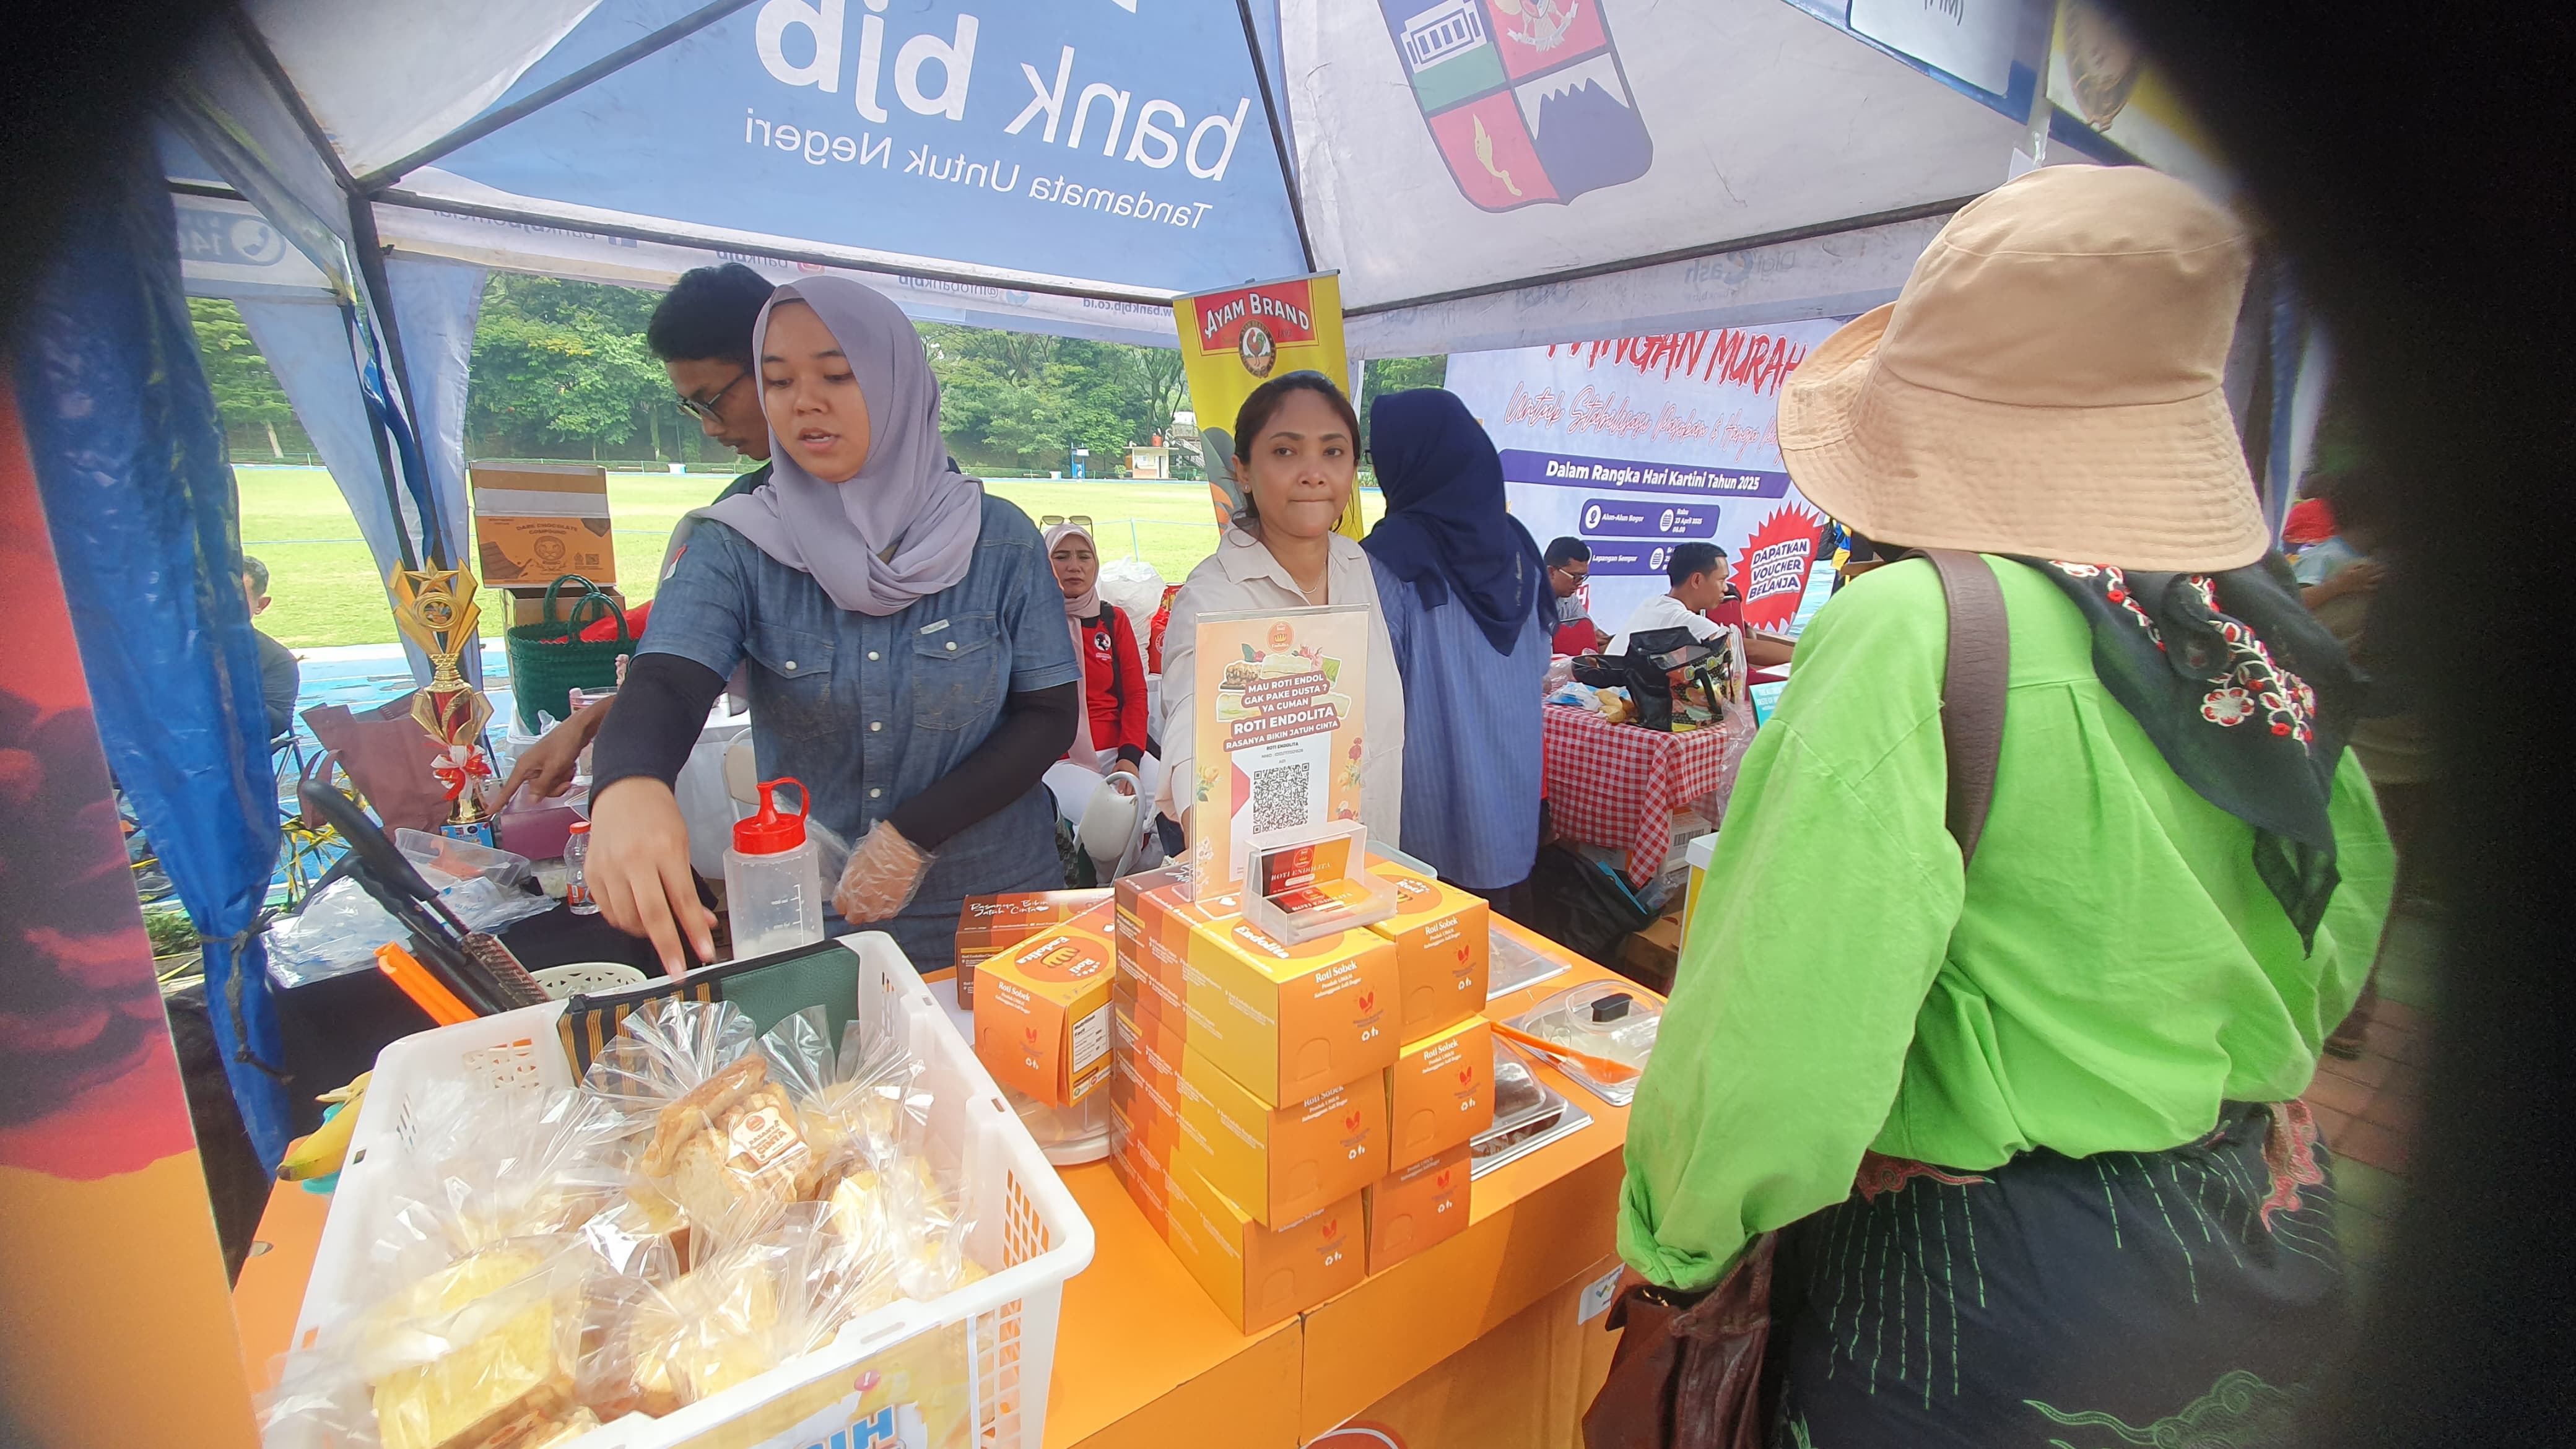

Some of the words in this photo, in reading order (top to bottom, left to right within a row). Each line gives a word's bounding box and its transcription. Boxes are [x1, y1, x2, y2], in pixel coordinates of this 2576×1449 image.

[1204, 298, 1245, 339] AYAM
[1248, 292, 1310, 330] BRAND
[1703, 329, 1808, 398] MURAH
[1503, 381, 1565, 428] Untuk
[1546, 460, 1589, 481] Dalam
[1591, 464, 1640, 485] Rangka
[1643, 468, 1668, 485] Hari
[1670, 471, 1706, 488] Kartini
[1707, 473, 1737, 490] Tahun
[1737, 476, 1760, 490] 2025
[536, 523, 578, 532] CHOCOLATE
[1601, 513, 1628, 521] Alun-Alun
[1629, 515, 1644, 523] Bogor
[1592, 554, 1618, 563] Lapangan
[1618, 555, 1638, 564] Sempur
[1752, 540, 1808, 565] DAPATKAN
[1753, 559, 1802, 581] VOUCHER
[1749, 577, 1799, 599] BELANJA
[1248, 683, 1269, 693] MAU
[1271, 679, 1292, 689] ROTI
[1294, 674, 1324, 685] ENDOL
[1244, 694, 1264, 705] GAK
[1266, 690, 1290, 702] PAKE
[1292, 685, 1320, 697] DUSTA
[1262, 705, 1274, 713] YA
[1276, 698, 1308, 710] CUMAN
[1234, 718, 1266, 735] ROTI
[1269, 706, 1334, 728] ENDOLITA
[1226, 736, 1264, 749] RASANYA
[1266, 730, 1288, 741] BIKIN
[1289, 725, 1314, 736] JATUH
[1316, 720, 1338, 730] CINTA
[1271, 871, 1290, 881] ROTI
[1292, 862, 1331, 876] ENDOLITA
[1396, 880, 1425, 894] Roti
[970, 902, 1014, 911] Rasanya
[974, 908, 1004, 917] Jatuh
[1010, 907, 1036, 915] Cinta
[1425, 924, 1438, 935] Roti
[1439, 916, 1458, 930] Sobek
[1016, 936, 1070, 964] Endolita
[1234, 926, 1289, 959] Endolita
[1068, 957, 1095, 973] Roti
[1315, 968, 1332, 983] Roti
[1333, 960, 1357, 977] Sobek
[998, 981, 1011, 991] Roti
[1012, 988, 1030, 1001] Sobek
[1424, 1048, 1438, 1060] Roti
[1438, 1038, 1458, 1053] Sobek
